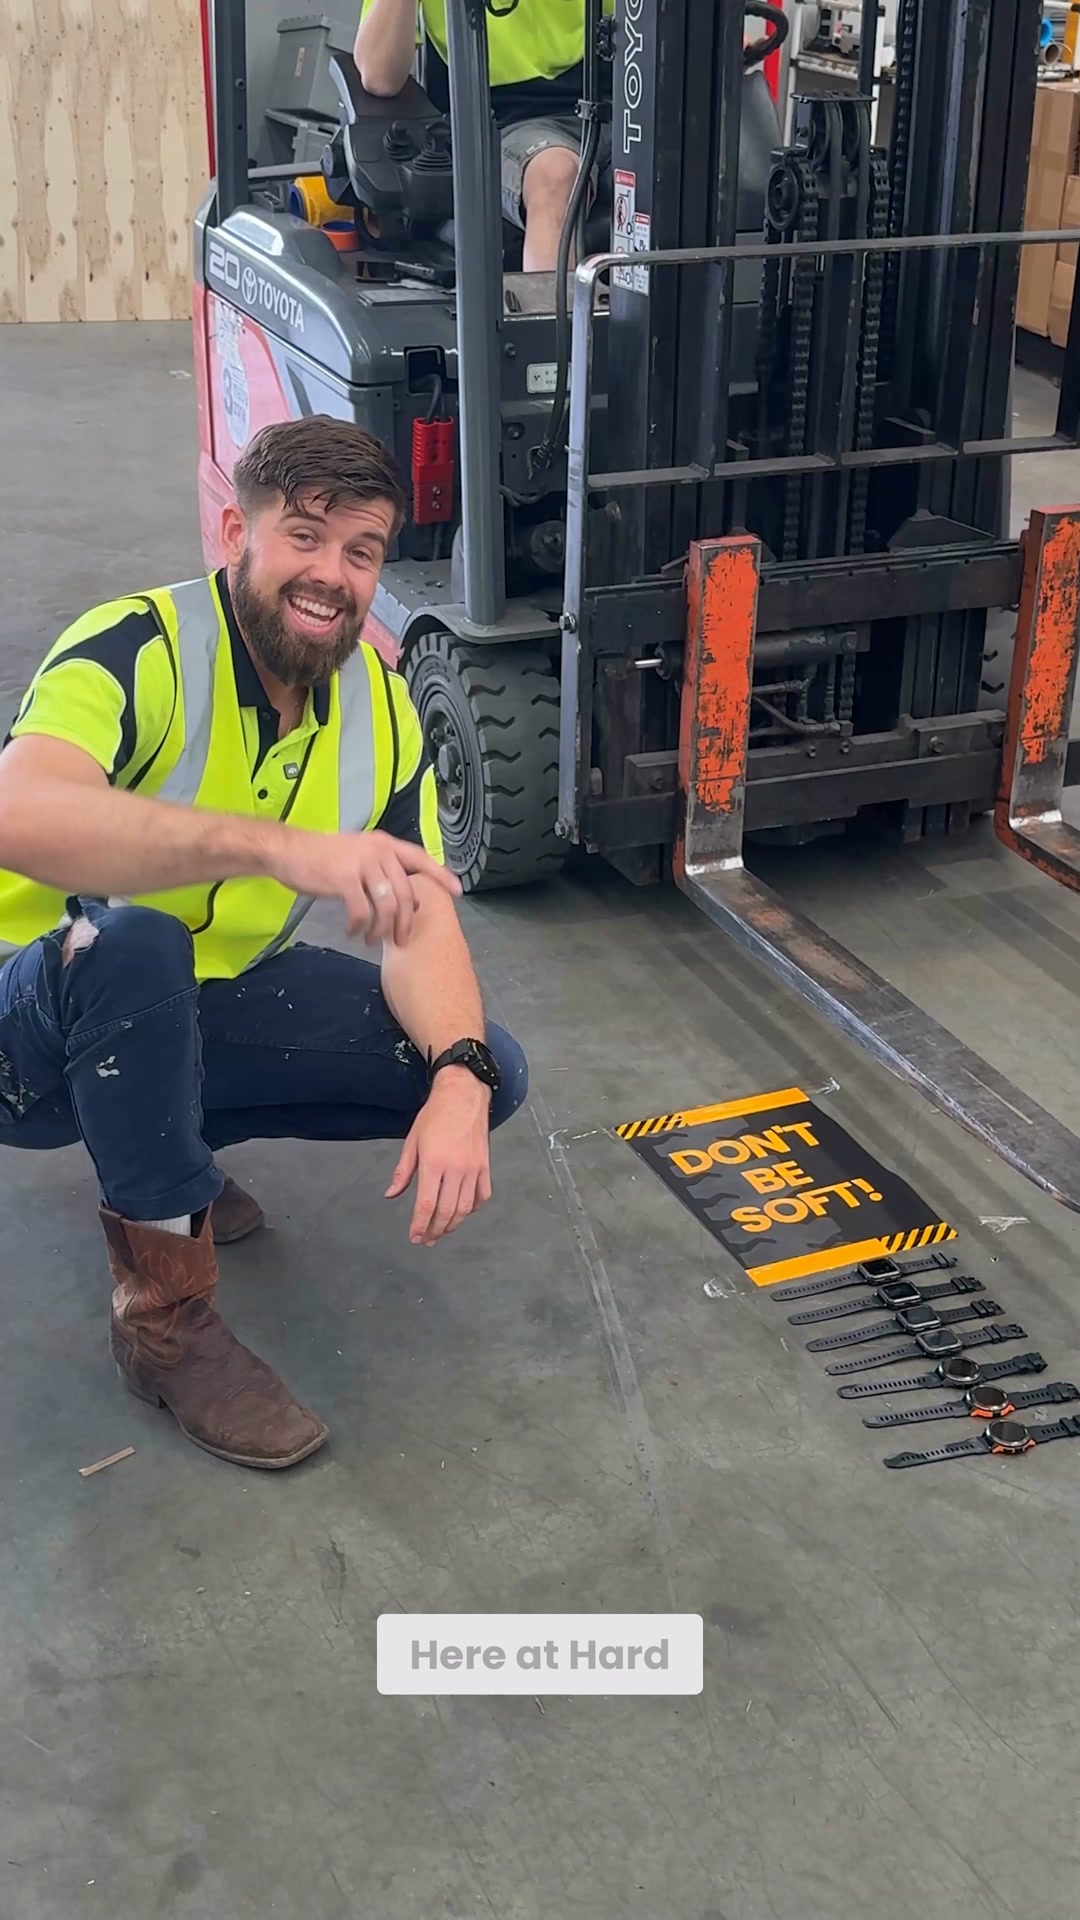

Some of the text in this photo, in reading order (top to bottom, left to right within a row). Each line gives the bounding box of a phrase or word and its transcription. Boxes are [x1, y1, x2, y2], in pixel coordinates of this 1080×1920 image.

[209, 241, 240, 290] 20
[257, 277, 305, 333] TOYOTA
[668, 1121, 820, 1176] DON'T
[740, 1160, 815, 1195] BE
[730, 1178, 884, 1233] SOFT!
